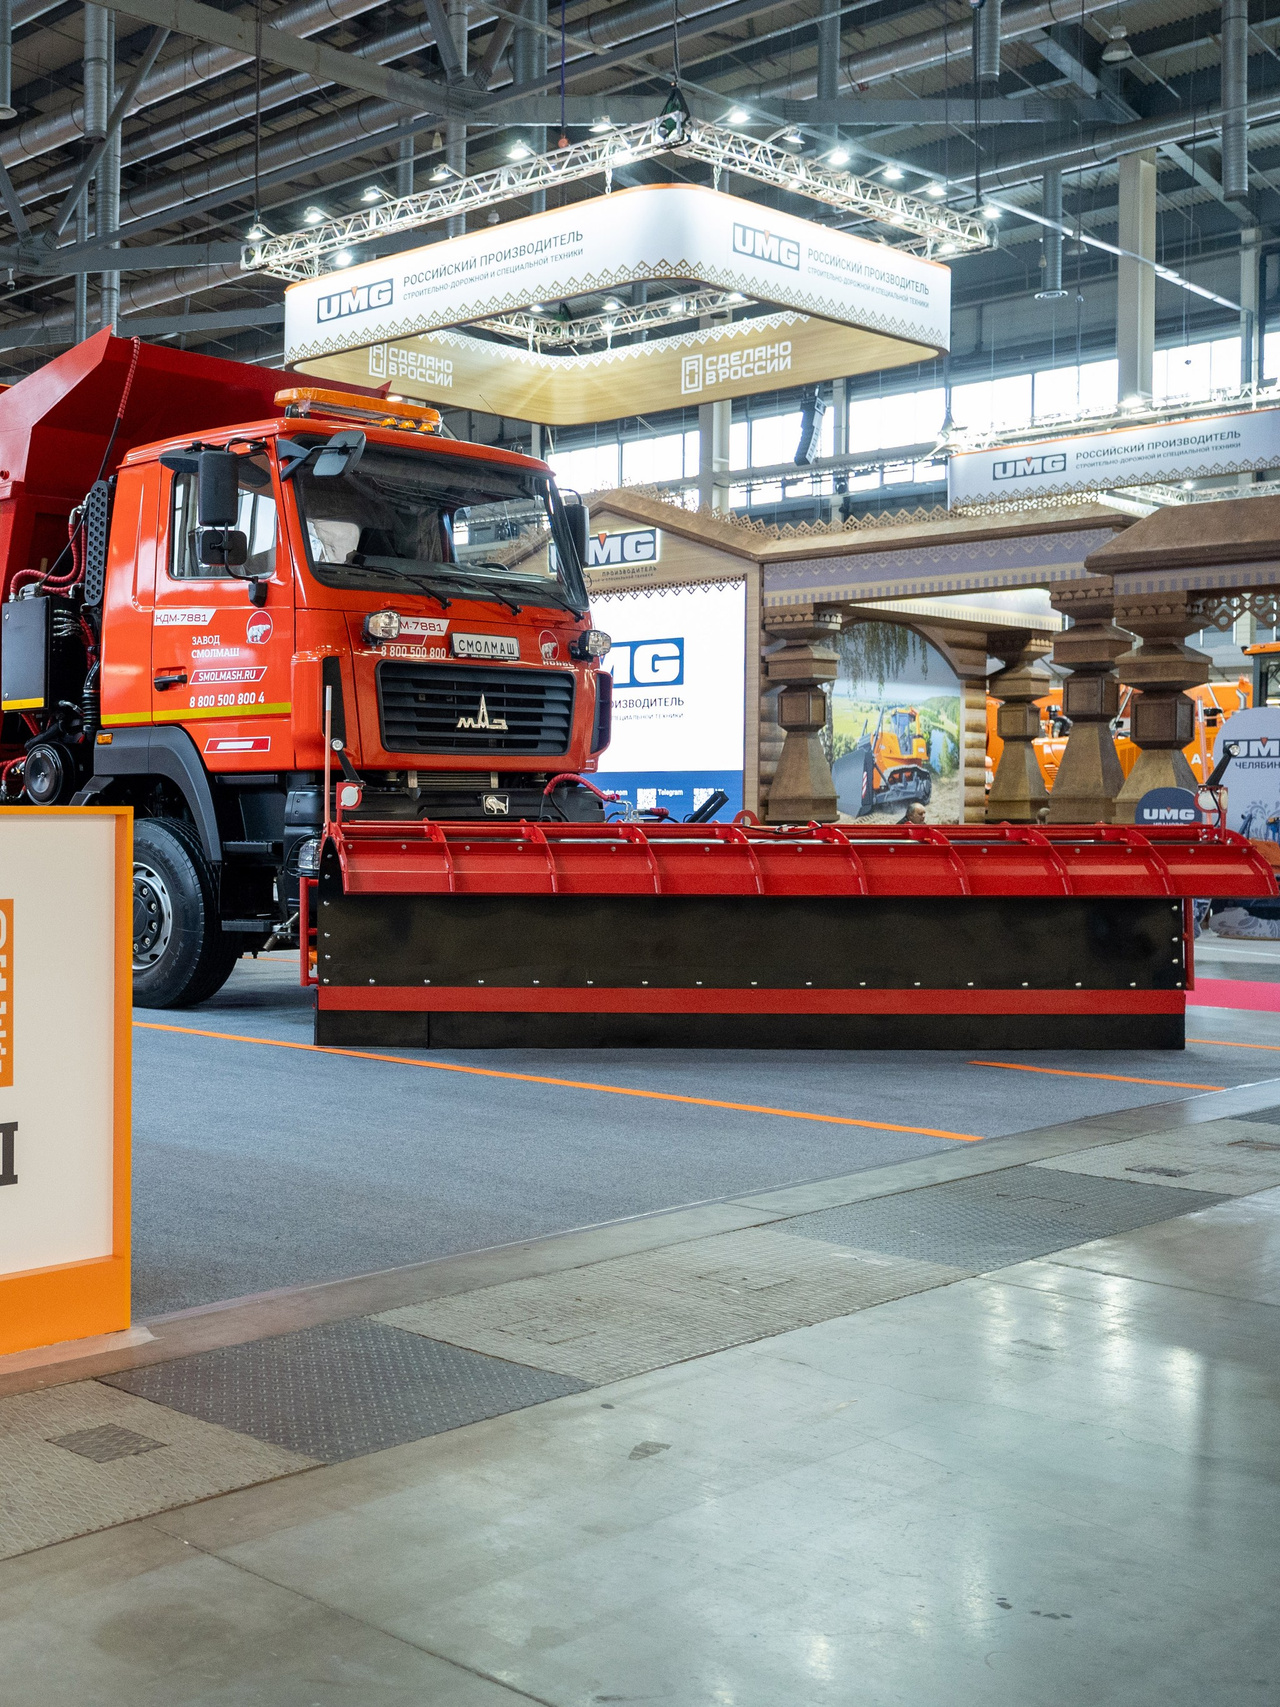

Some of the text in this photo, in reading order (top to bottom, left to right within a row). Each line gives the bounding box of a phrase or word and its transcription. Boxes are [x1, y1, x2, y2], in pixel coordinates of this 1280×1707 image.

[734, 224, 799, 269] UMG
[404, 230, 584, 287] РОССИЙСКИЙ ПРОИЗВОДИТЕЛЬ
[403, 271, 489, 300] СТРОИТЕЛЬНО-ДОРОЖНОЙ
[497, 257, 548, 277] СПЕЦИАЛЬНОЙ
[550, 248, 584, 263] ТЕХНИКИ
[808, 248, 930, 296] РОССИЙСКИЙ ПРОИЗВОДИТЕЛЬ
[318, 281, 392, 321] UMG
[388, 347, 453, 374] СДЕЛАНО
[705, 341, 792, 370] СДЕЛАНО
[1076, 430, 1241, 460] РОССИЙСКИЙ ПРОИЗВОДИТЕЛЬ
[1163, 446, 1210, 459] СПЕЦИАЛЬНОЙ
[994, 455, 1065, 480] UMG
[550, 532, 656, 567] MG
[602, 566, 657, 577] ПРОИЗВОДИТЕЛЬ
[155, 613, 208, 624] КДМ-7881
[191, 635, 220, 646] ЗАВОД
[458, 639, 515, 655] СМОЛМАШ
[191, 647, 240, 658] СМОЛМАШ
[381, 646, 387, 657] 8
[389, 646, 408, 657] 800
[410, 647, 427, 658] 500
[429, 647, 447, 659] 800
[198, 670, 257, 682] SMOLMASH.RU
[189, 691, 265, 708] 8 800 500 800 4
[658, 788, 683, 797] Telegram
[1143, 808, 1195, 820] UMG
